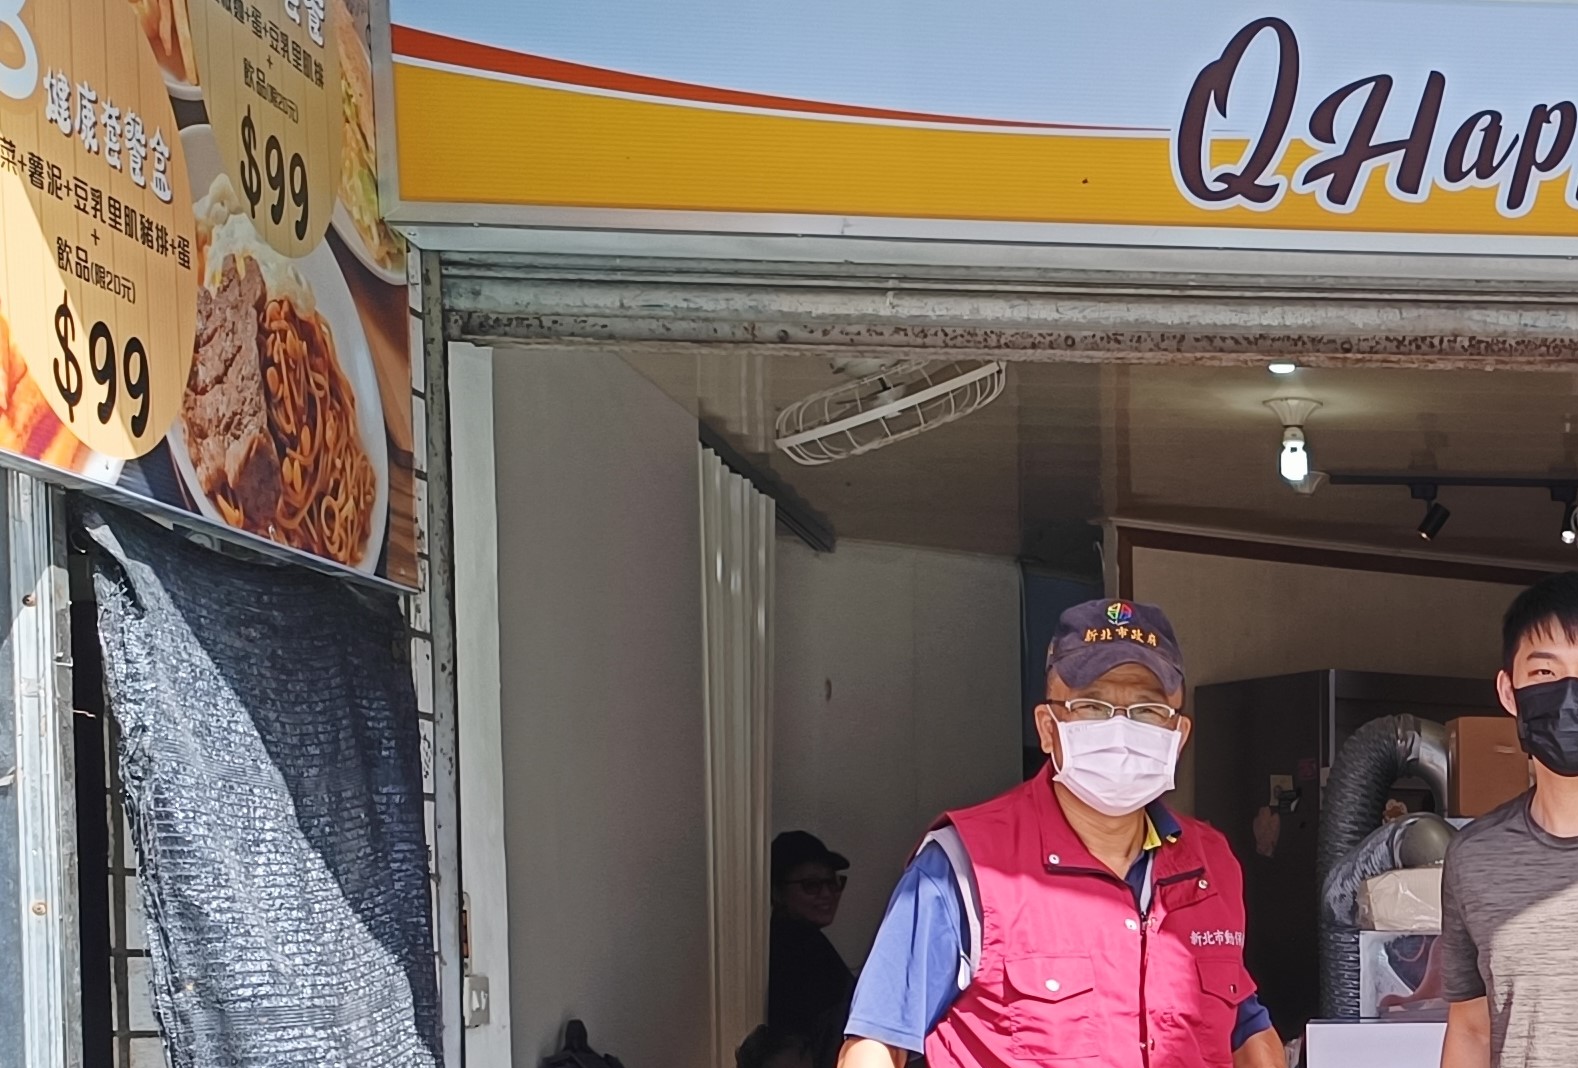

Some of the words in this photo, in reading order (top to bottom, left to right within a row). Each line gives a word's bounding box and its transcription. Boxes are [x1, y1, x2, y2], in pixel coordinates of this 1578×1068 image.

[43, 65, 174, 204] 健康套餐盒
[239, 104, 308, 241] $99
[56, 235, 137, 305] 飲品(限20元)
[53, 288, 150, 439] $99
[1084, 626, 1157, 647] 新北市政府
